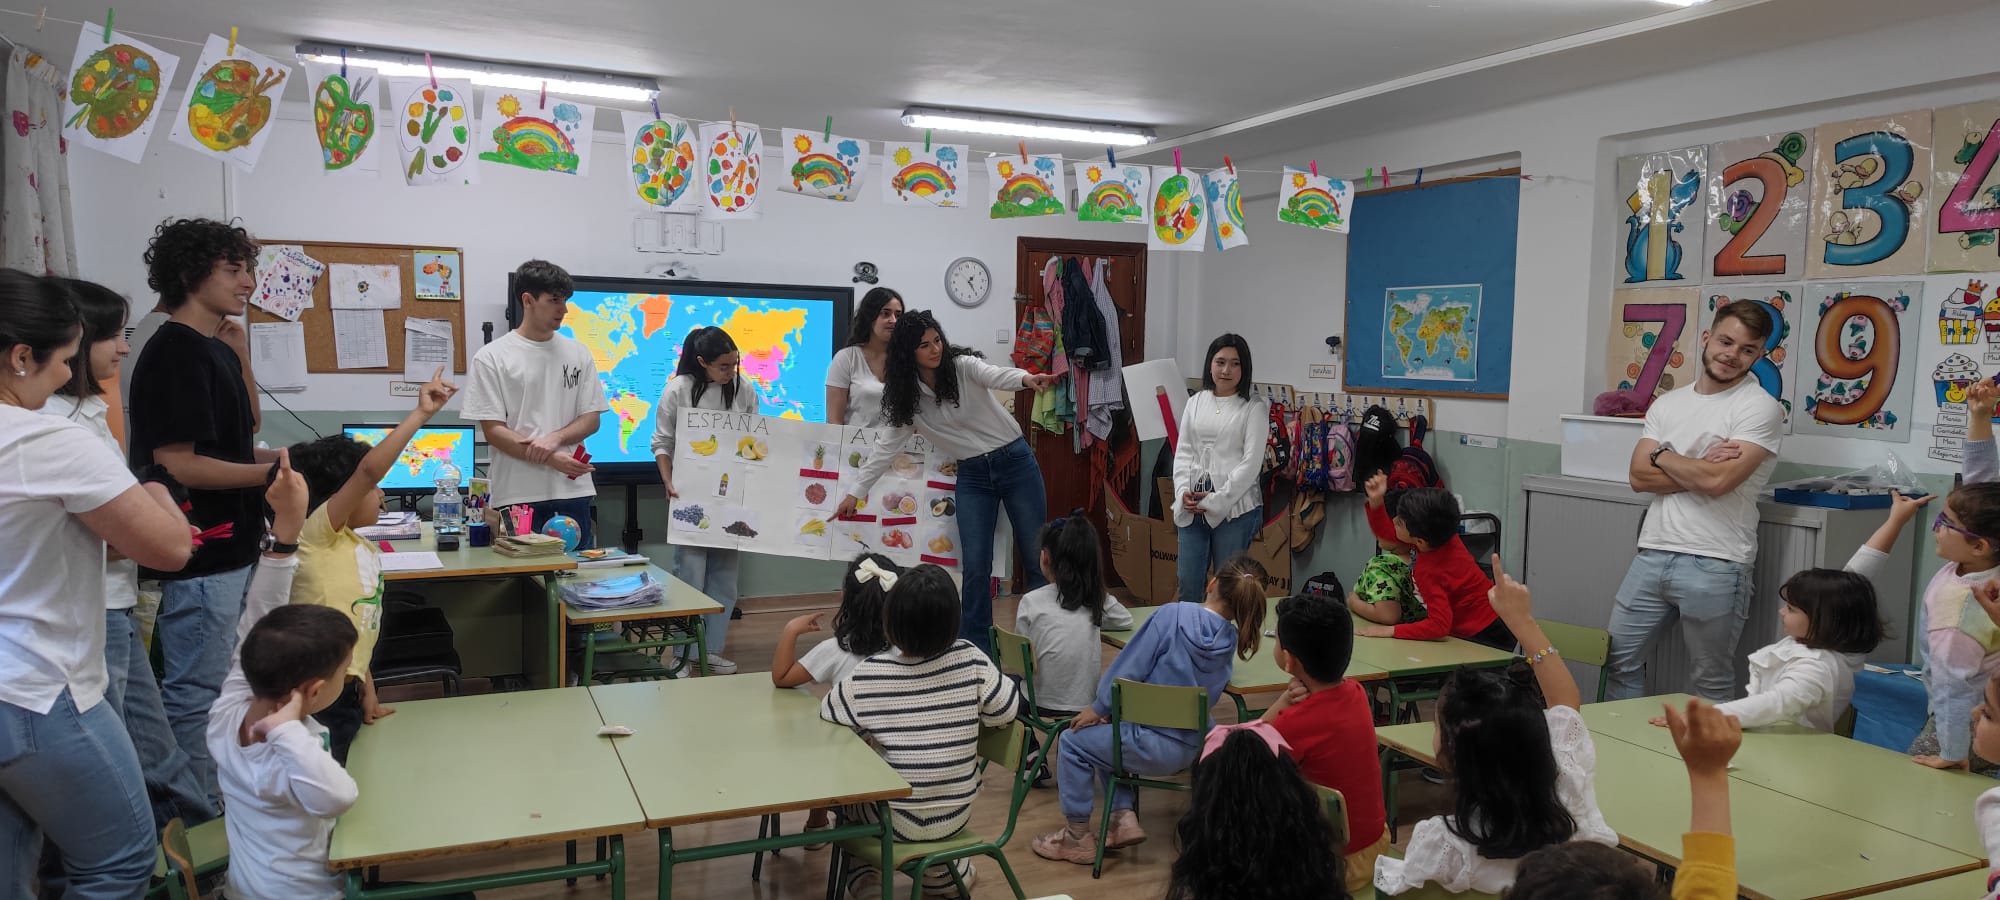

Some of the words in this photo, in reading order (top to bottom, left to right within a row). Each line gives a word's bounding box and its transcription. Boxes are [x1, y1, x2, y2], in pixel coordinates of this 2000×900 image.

[1713, 156, 1788, 277] 2
[1824, 130, 1914, 266] 3
[1623, 303, 1687, 402] 7
[1814, 295, 1900, 425] 9
[687, 412, 769, 436] ESPAÑA
